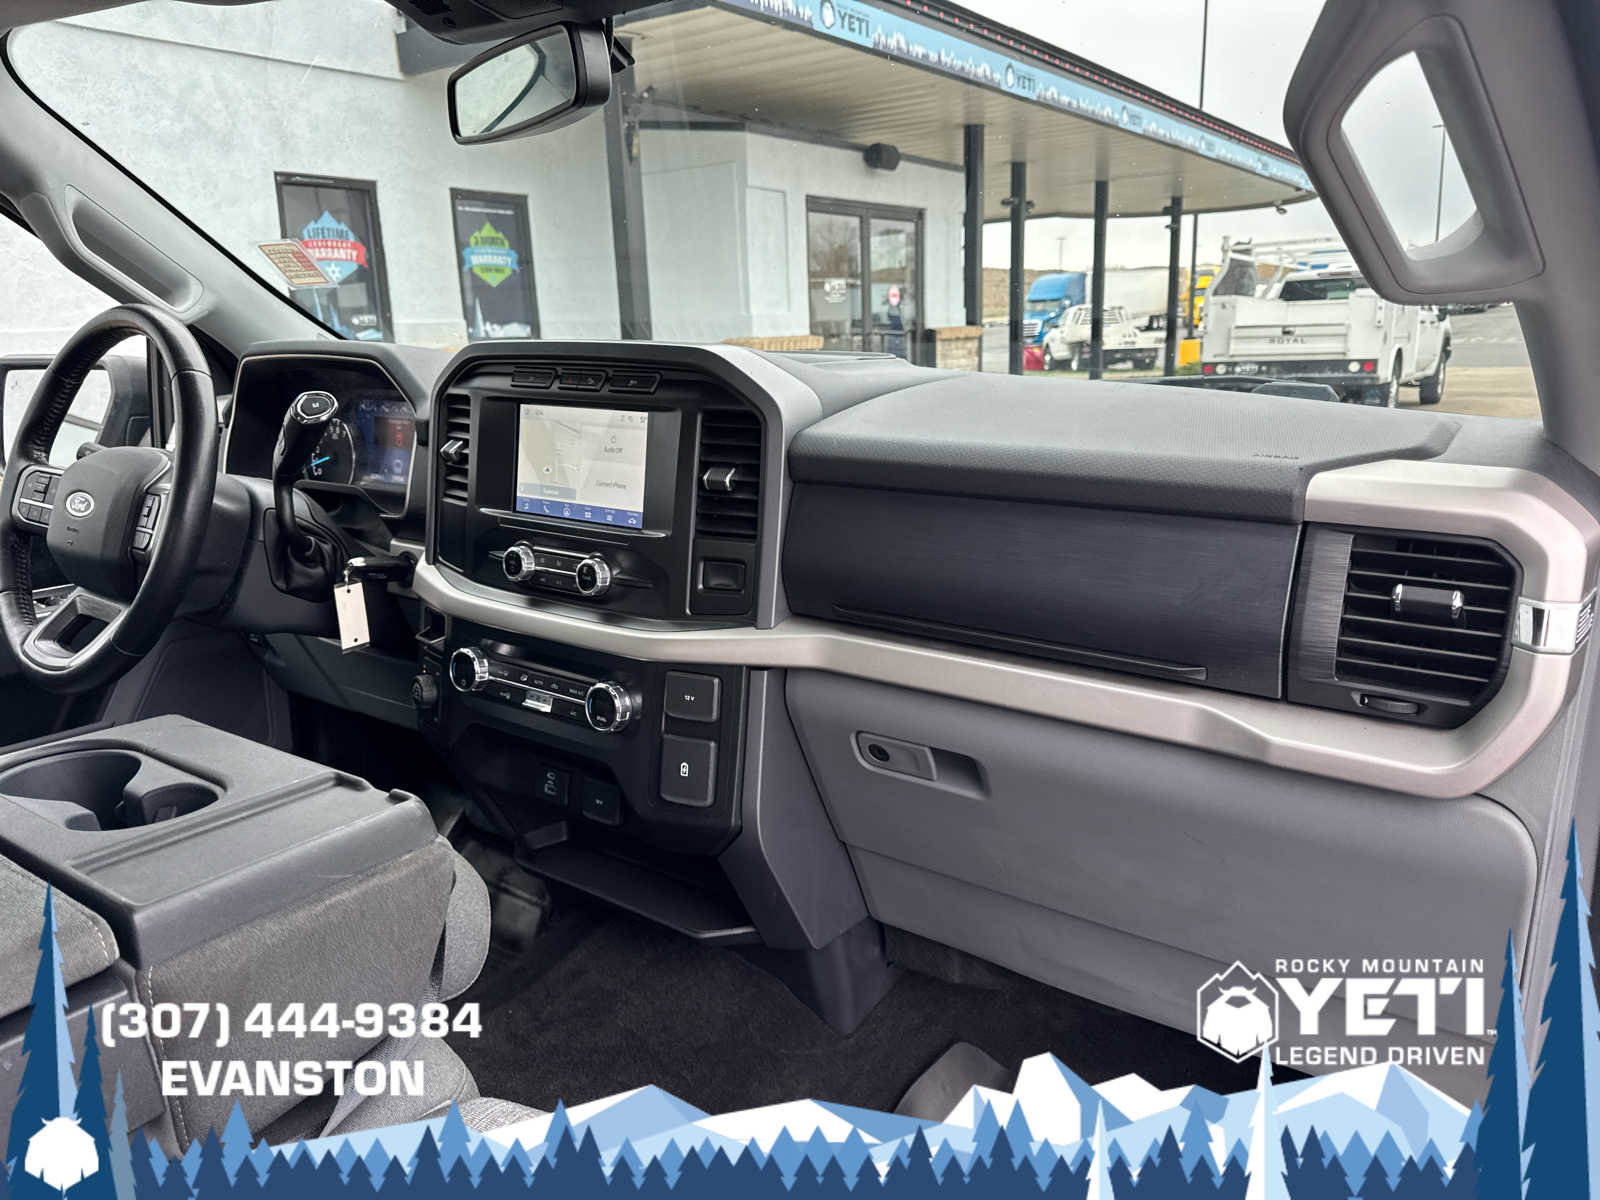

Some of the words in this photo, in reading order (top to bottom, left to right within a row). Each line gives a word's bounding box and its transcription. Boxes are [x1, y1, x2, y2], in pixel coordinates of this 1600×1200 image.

[837, 9, 870, 38] YETI
[306, 227, 349, 241] LIFETIME
[1268, 337, 1307, 345] ROYAL
